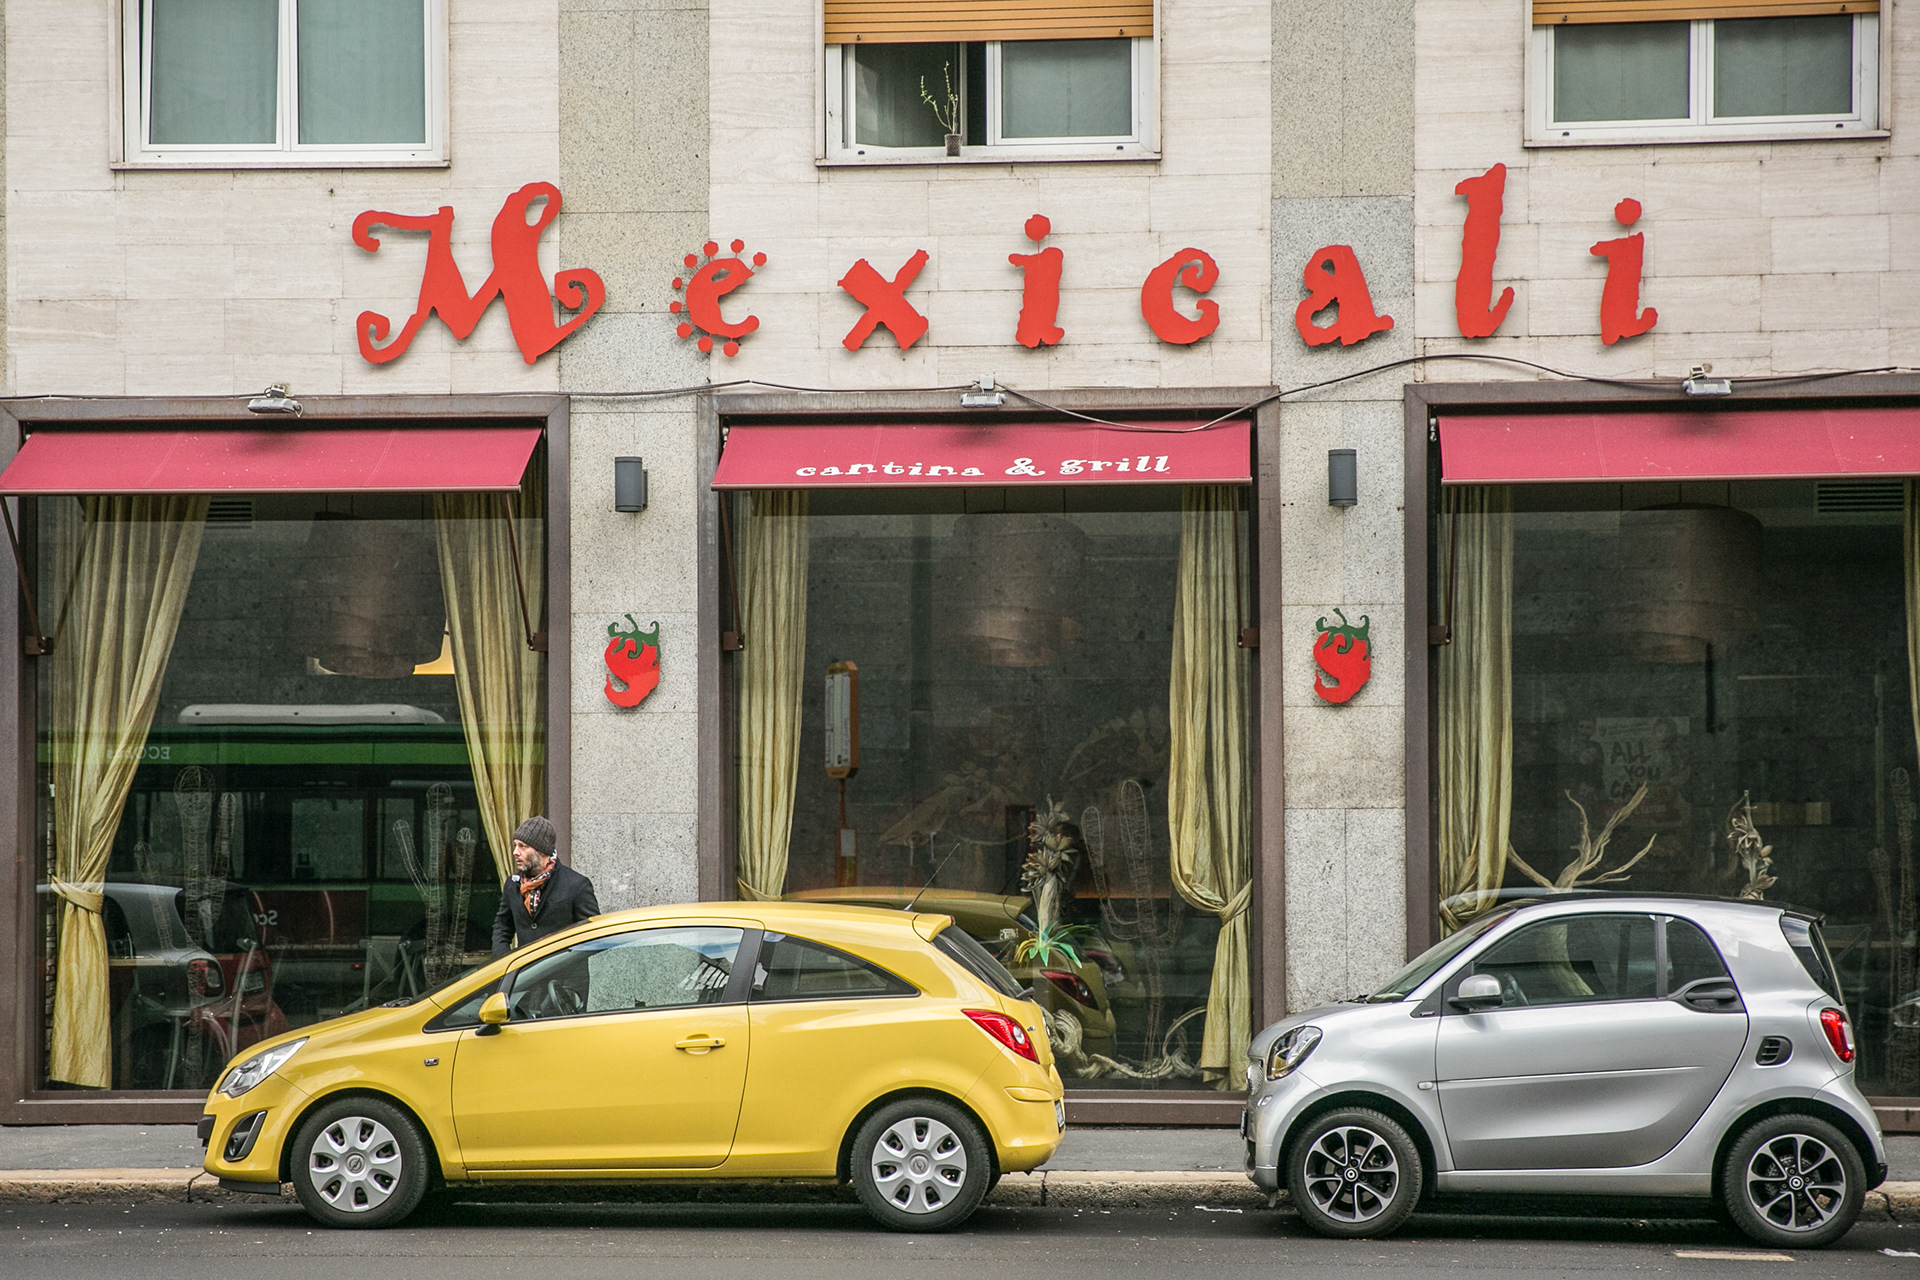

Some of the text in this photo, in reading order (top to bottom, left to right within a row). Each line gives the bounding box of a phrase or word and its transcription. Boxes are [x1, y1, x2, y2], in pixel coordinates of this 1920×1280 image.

[352, 163, 1657, 364] Mexicali
[795, 455, 1170, 477] cantina & grill
[1610, 740, 1651, 765] ALL
[1624, 765, 1660, 783] YOU
[1611, 780, 1645, 799] CA
